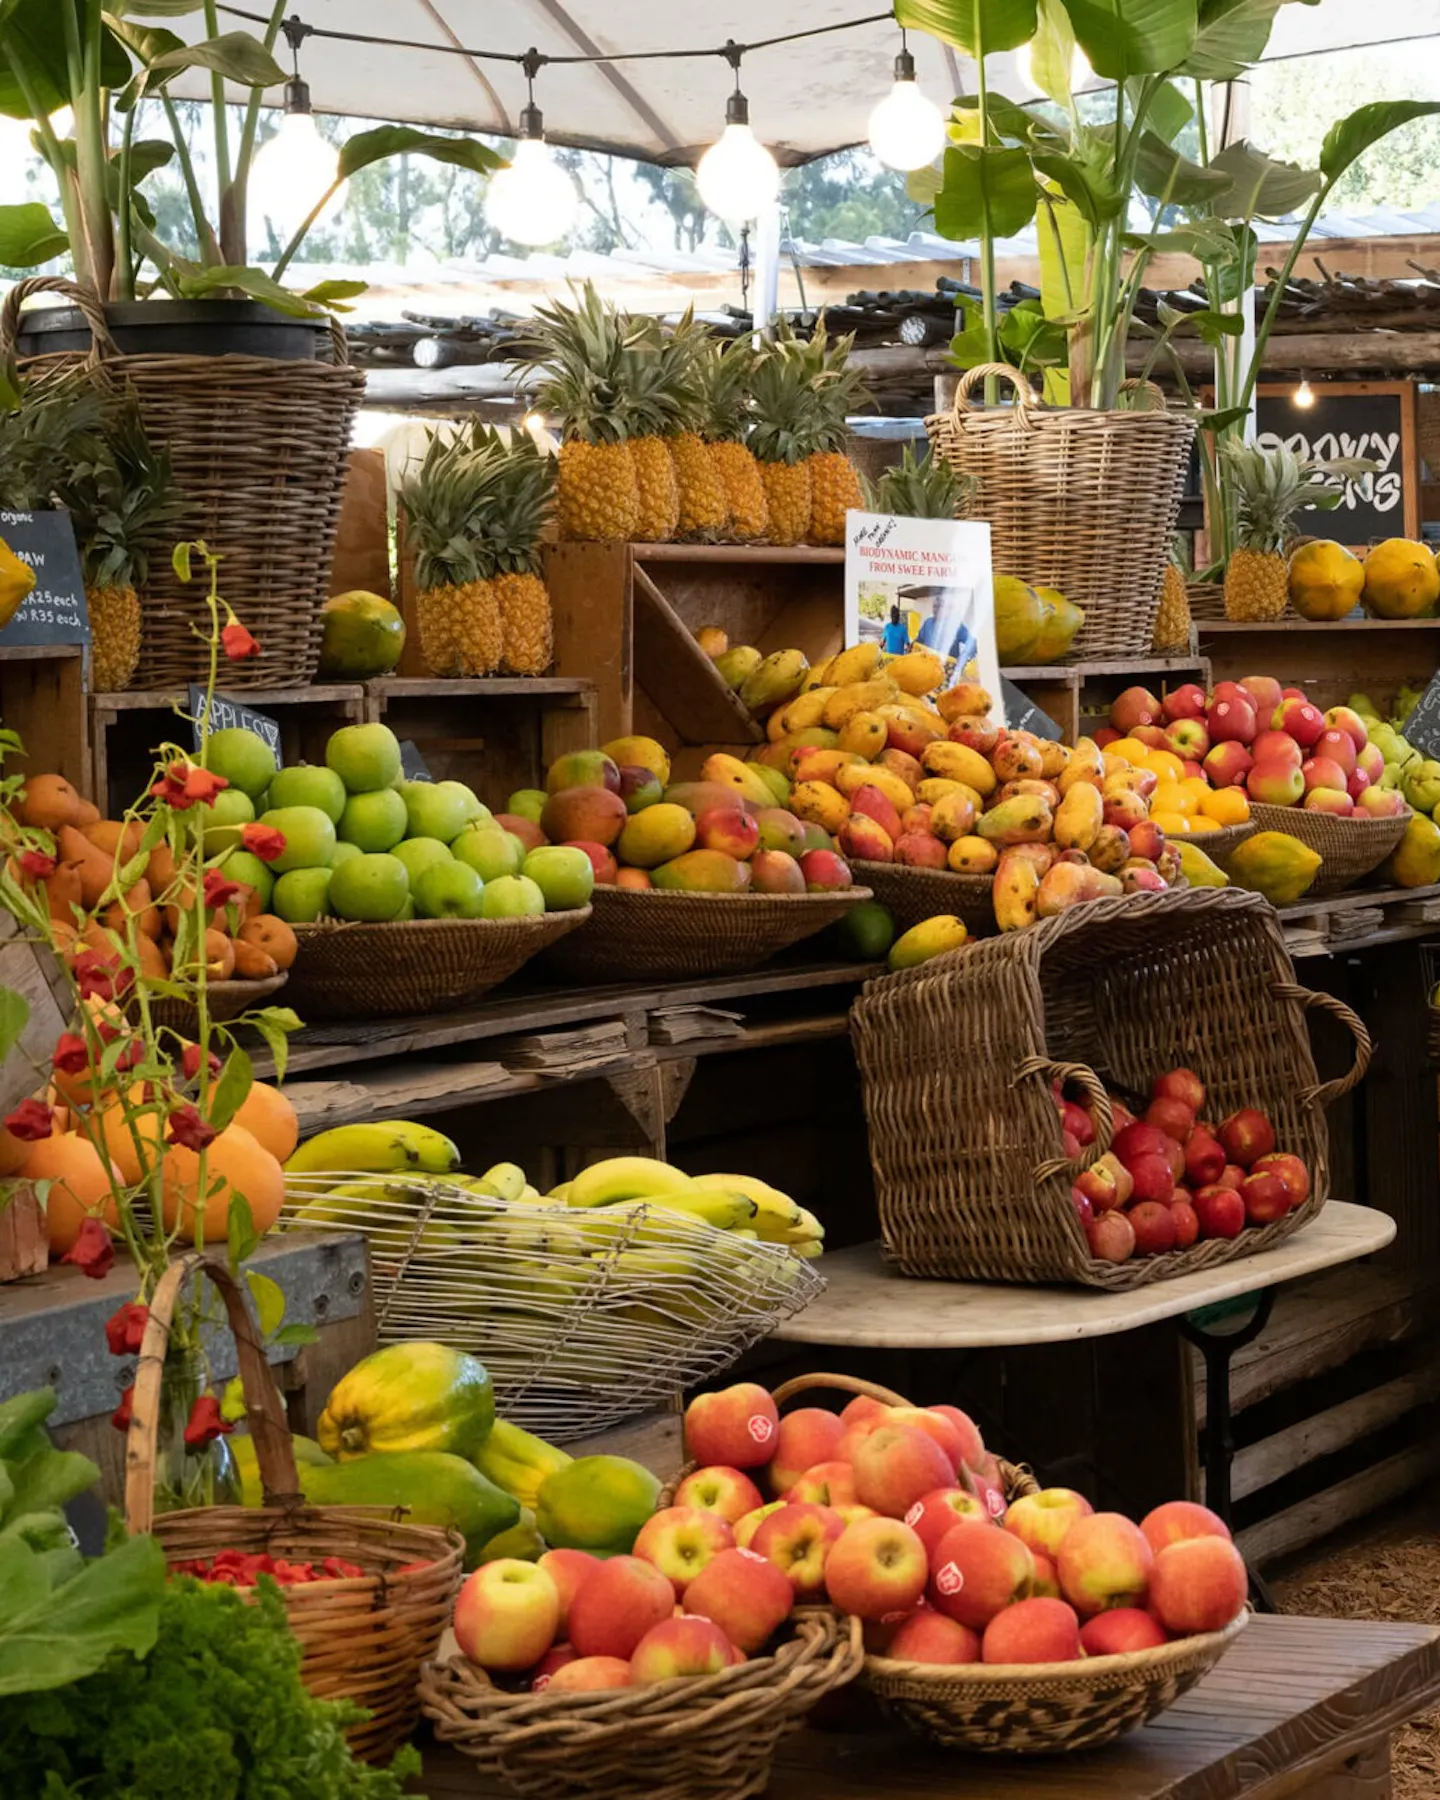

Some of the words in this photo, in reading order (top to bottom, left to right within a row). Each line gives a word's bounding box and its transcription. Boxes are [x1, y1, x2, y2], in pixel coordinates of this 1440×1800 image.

[859, 546, 919, 562] BIODYNAMIC
[869, 561, 896, 574] FROM
[897, 564, 925, 576] SWEE
[28, 590, 52, 605] R25
[54, 593, 78, 607] each
[30, 608, 54, 623] R35
